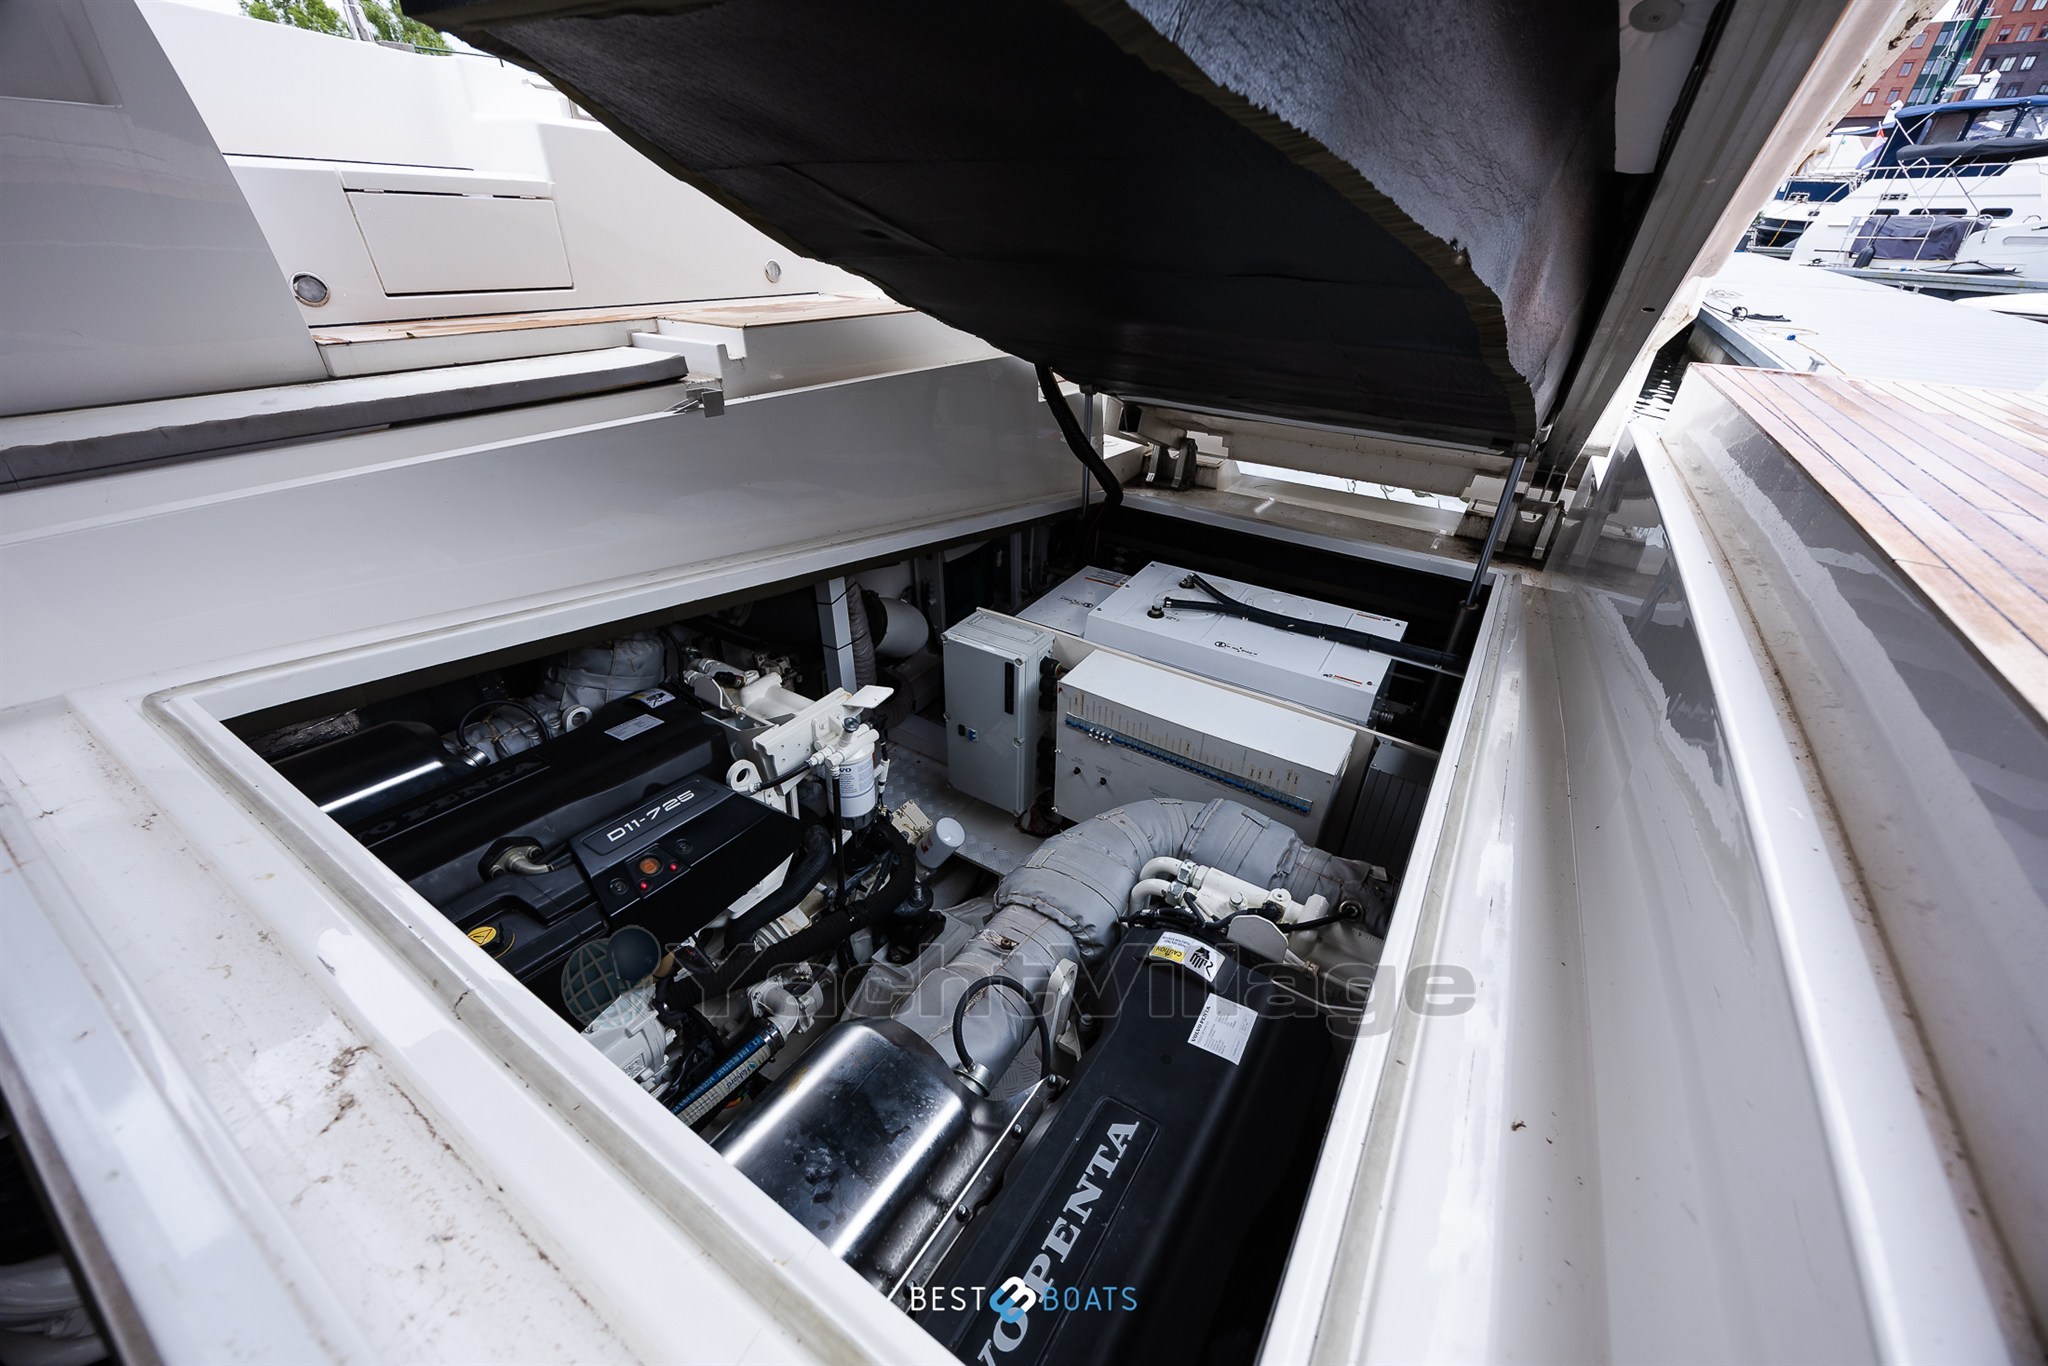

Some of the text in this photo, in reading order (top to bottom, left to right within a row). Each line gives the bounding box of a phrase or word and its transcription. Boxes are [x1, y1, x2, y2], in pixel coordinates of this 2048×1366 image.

[402, 761, 543, 822] PENTA
[606, 790, 695, 842] D11-725
[1156, 946, 1183, 957] CAUTION
[1191, 1005, 1211, 1042] VOLVO PENTA
[1022, 1121, 1140, 1304] PENTA
